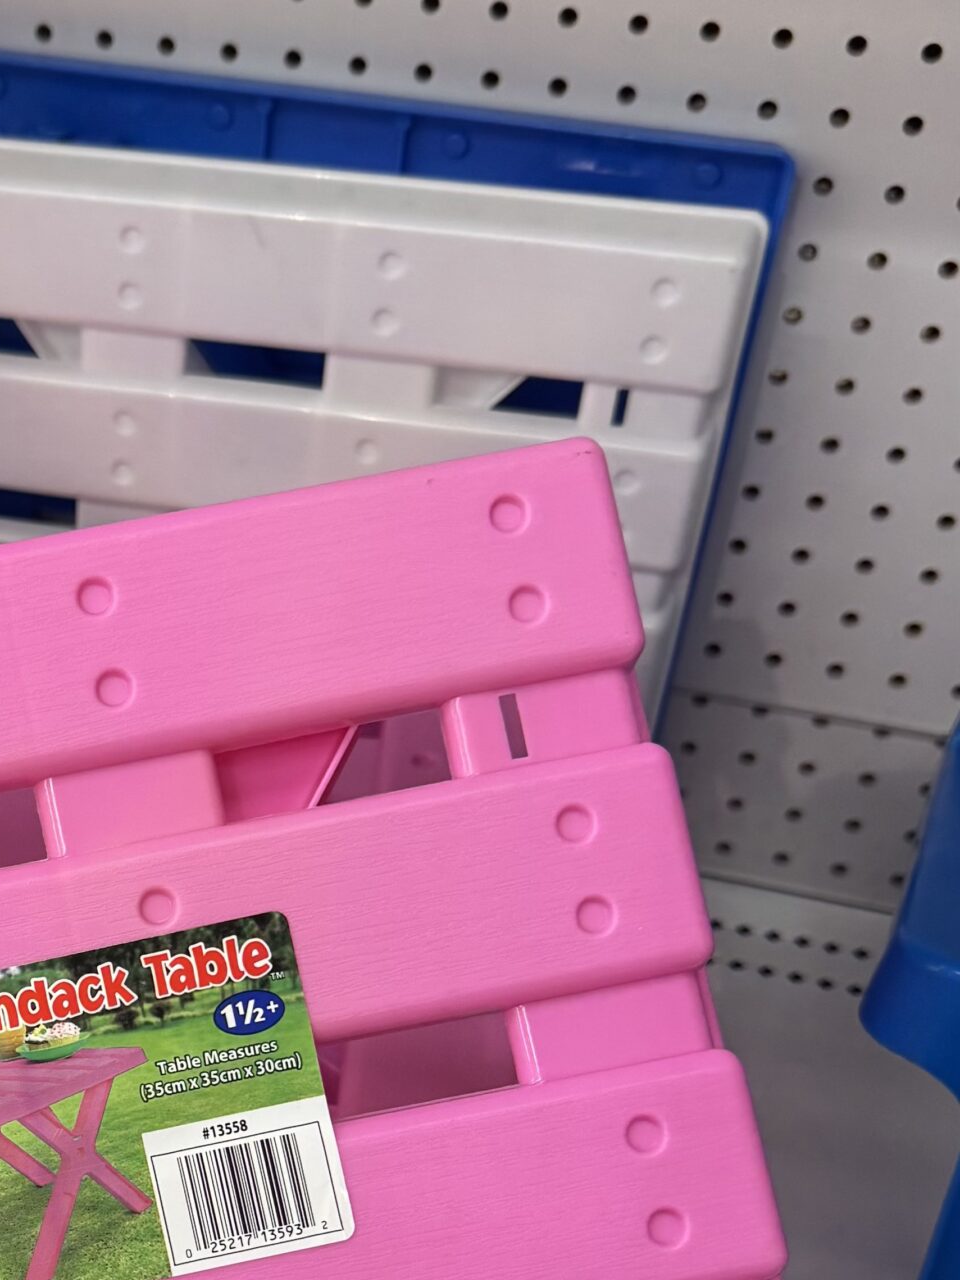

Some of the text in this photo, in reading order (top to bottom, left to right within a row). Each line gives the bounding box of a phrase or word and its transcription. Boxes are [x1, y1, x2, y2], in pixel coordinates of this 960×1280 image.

[141, 934, 273, 999] Table
[140, 1053, 302, 1101] (35cm x 35cm x 30cm)
[156, 1041, 278, 1075] Table Measures
[202, 1119, 248, 1140] #13558
[185, 1220, 328, 1259] 0 25217 13593 2
